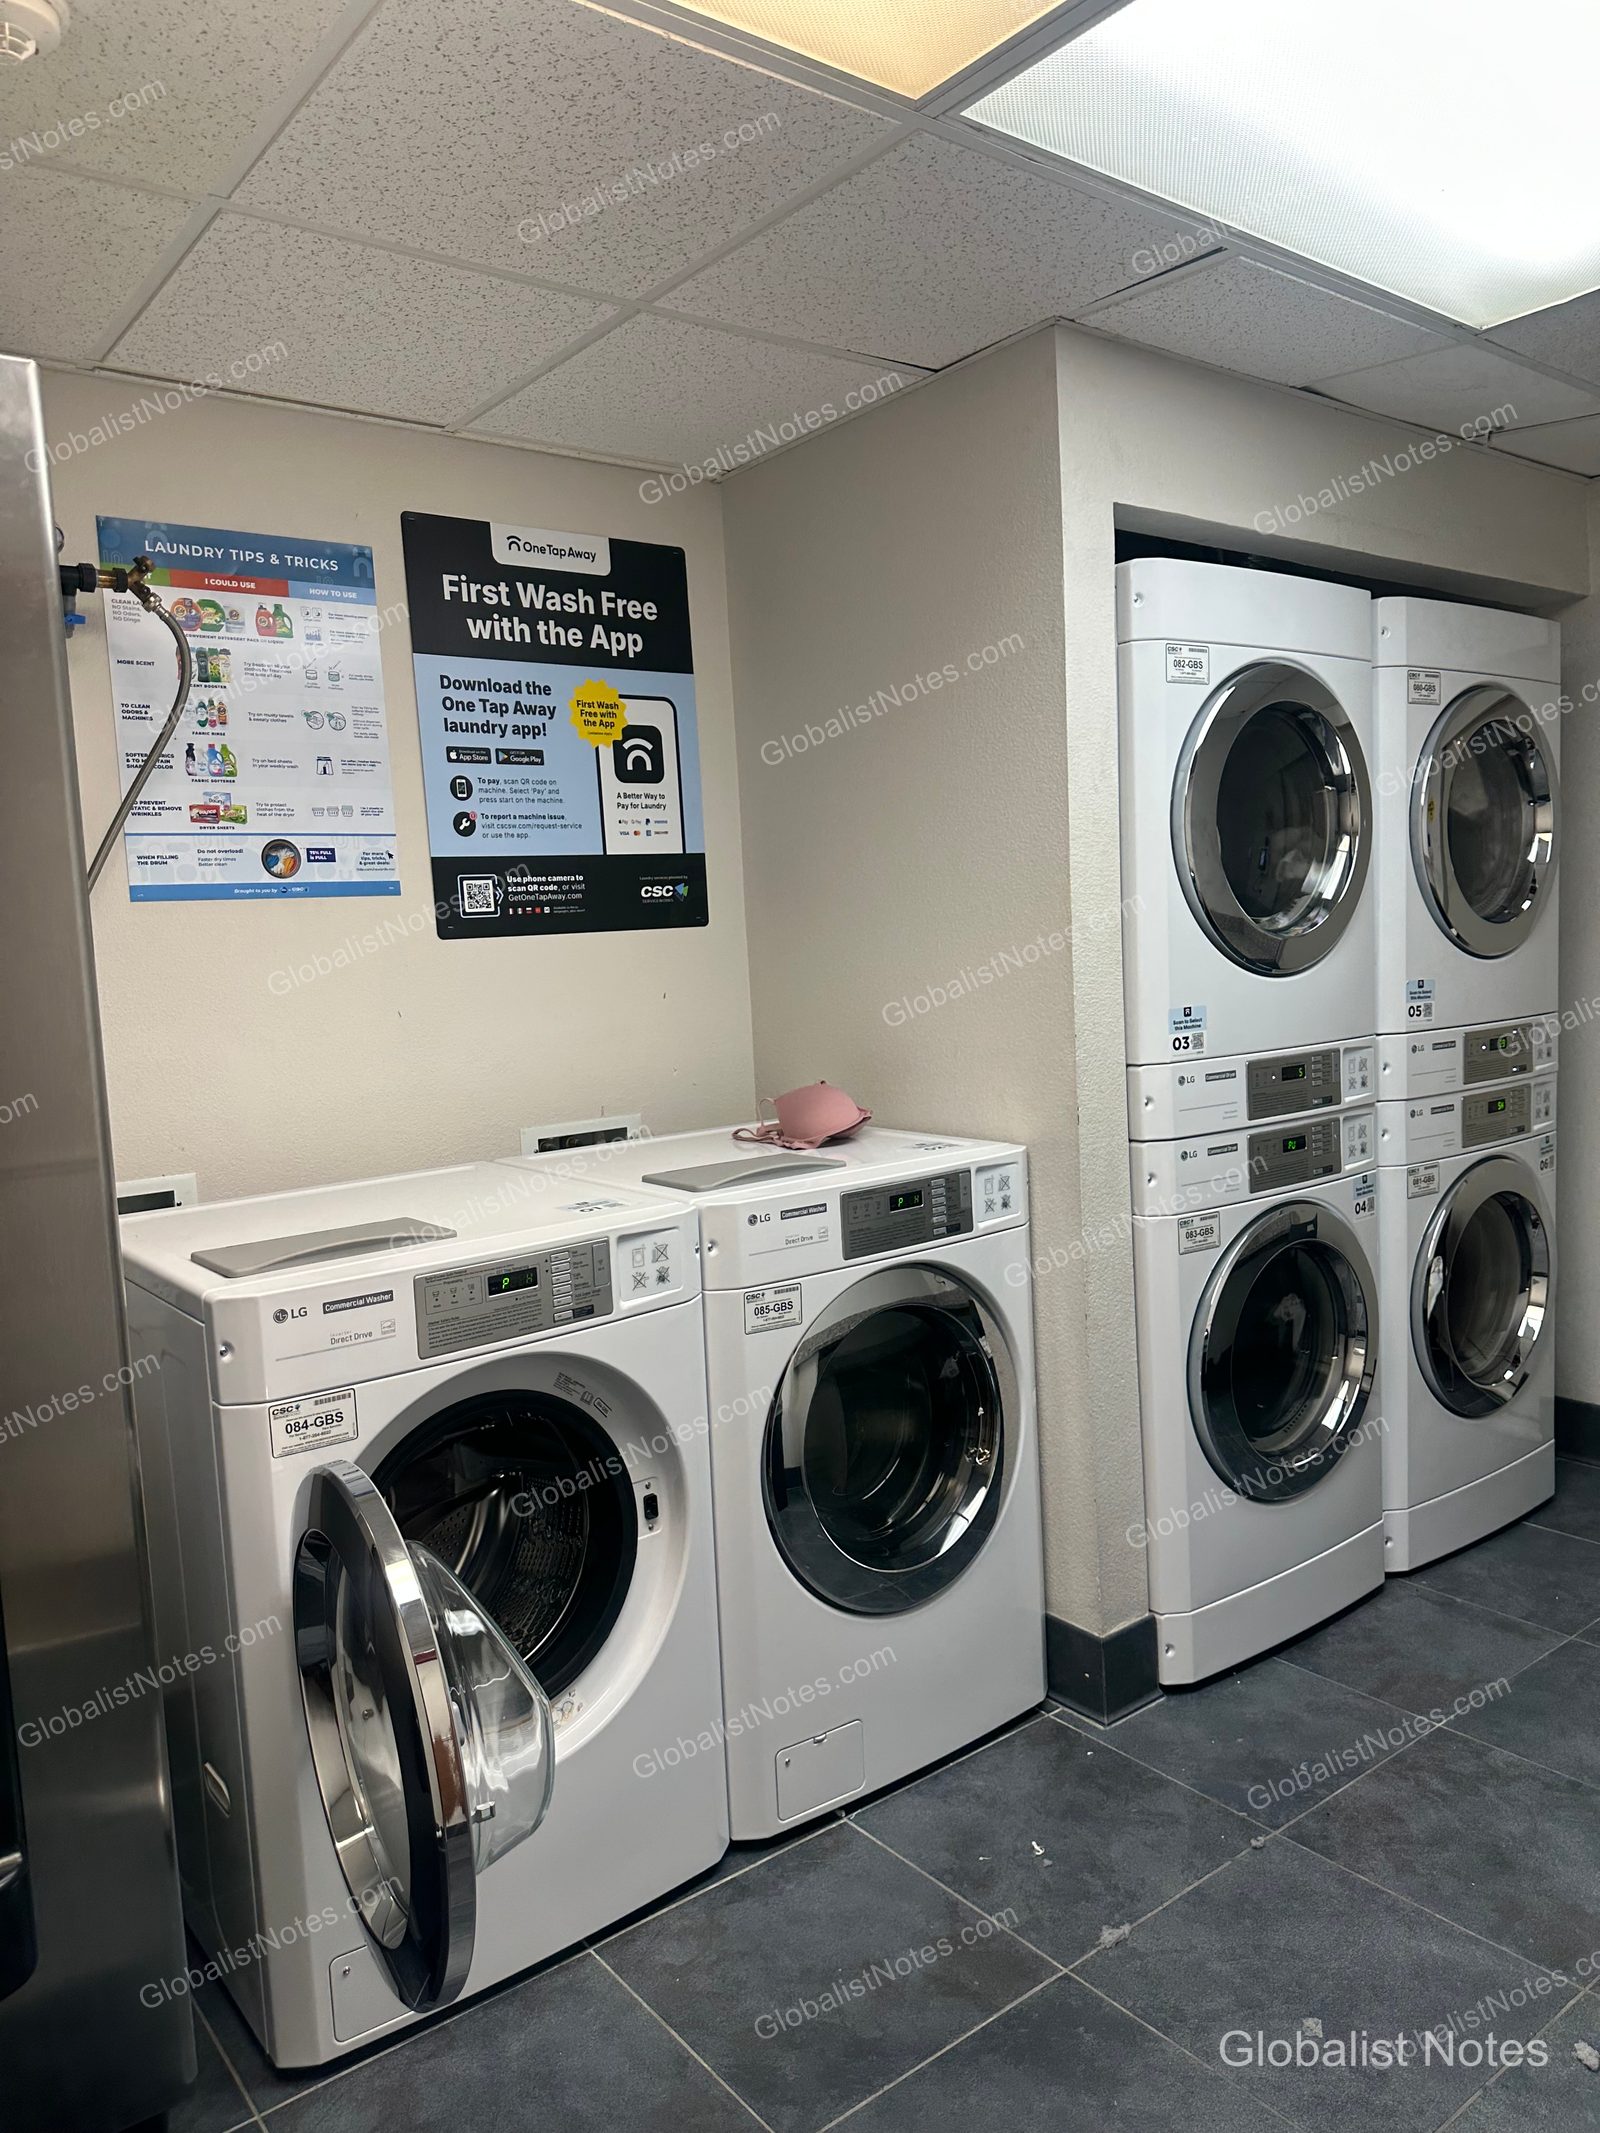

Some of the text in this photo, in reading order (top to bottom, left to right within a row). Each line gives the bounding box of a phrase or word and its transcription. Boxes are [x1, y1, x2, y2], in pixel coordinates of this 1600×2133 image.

[144, 540, 339, 571] LAUNDRY TIPS & TRICKS
[210, 578, 237, 588] COULD
[240, 581, 256, 589] USE
[309, 588, 327, 596] HOW
[342, 591, 357, 599] USE
[442, 573, 659, 621] First Wash Free
[466, 613, 644, 658] with the App
[1173, 659, 1204, 670] 082-GBS
[439, 674, 552, 696] Download the
[442, 696, 557, 720] One Tap Away
[576, 700, 619, 710] First Wash
[580, 709, 617, 719] Free with
[443, 717, 547, 740] laundry app!
[583, 718, 615, 729] the App
[459, 753, 471, 761] App
[509, 755, 541, 764] Google Play
[487, 778, 501, 786] pay,
[623, 792, 643, 800] Better
[643, 792, 659, 801] Way
[616, 802, 629, 811] Pay
[640, 802, 667, 811] Laundry
[523, 875, 546, 885] phone
[527, 884, 539, 892] QR
[539, 884, 561, 892] code,
[640, 885, 674, 898] CSC
[508, 892, 583, 902] GetOneTapAway.com
[1408, 1005, 1422, 1018] 05
[1172, 1036, 1190, 1051] 03
[898, 1197, 904, 1207] P
[782, 1209, 808, 1218] Commercial
[1354, 1201, 1367, 1215] 04
[759, 1213, 771, 1223] LG
[1185, 1226, 1214, 1240] 083-GBS
[502, 1277, 510, 1289] P
[324, 1293, 392, 1312] Commercial Washer
[291, 1307, 308, 1319] LG
[754, 1301, 794, 1316] 085-GBS
[330, 1331, 373, 1345] Direct Drive
[272, 1406, 294, 1416] CSC
[285, 1411, 344, 1434] 084-GBS
